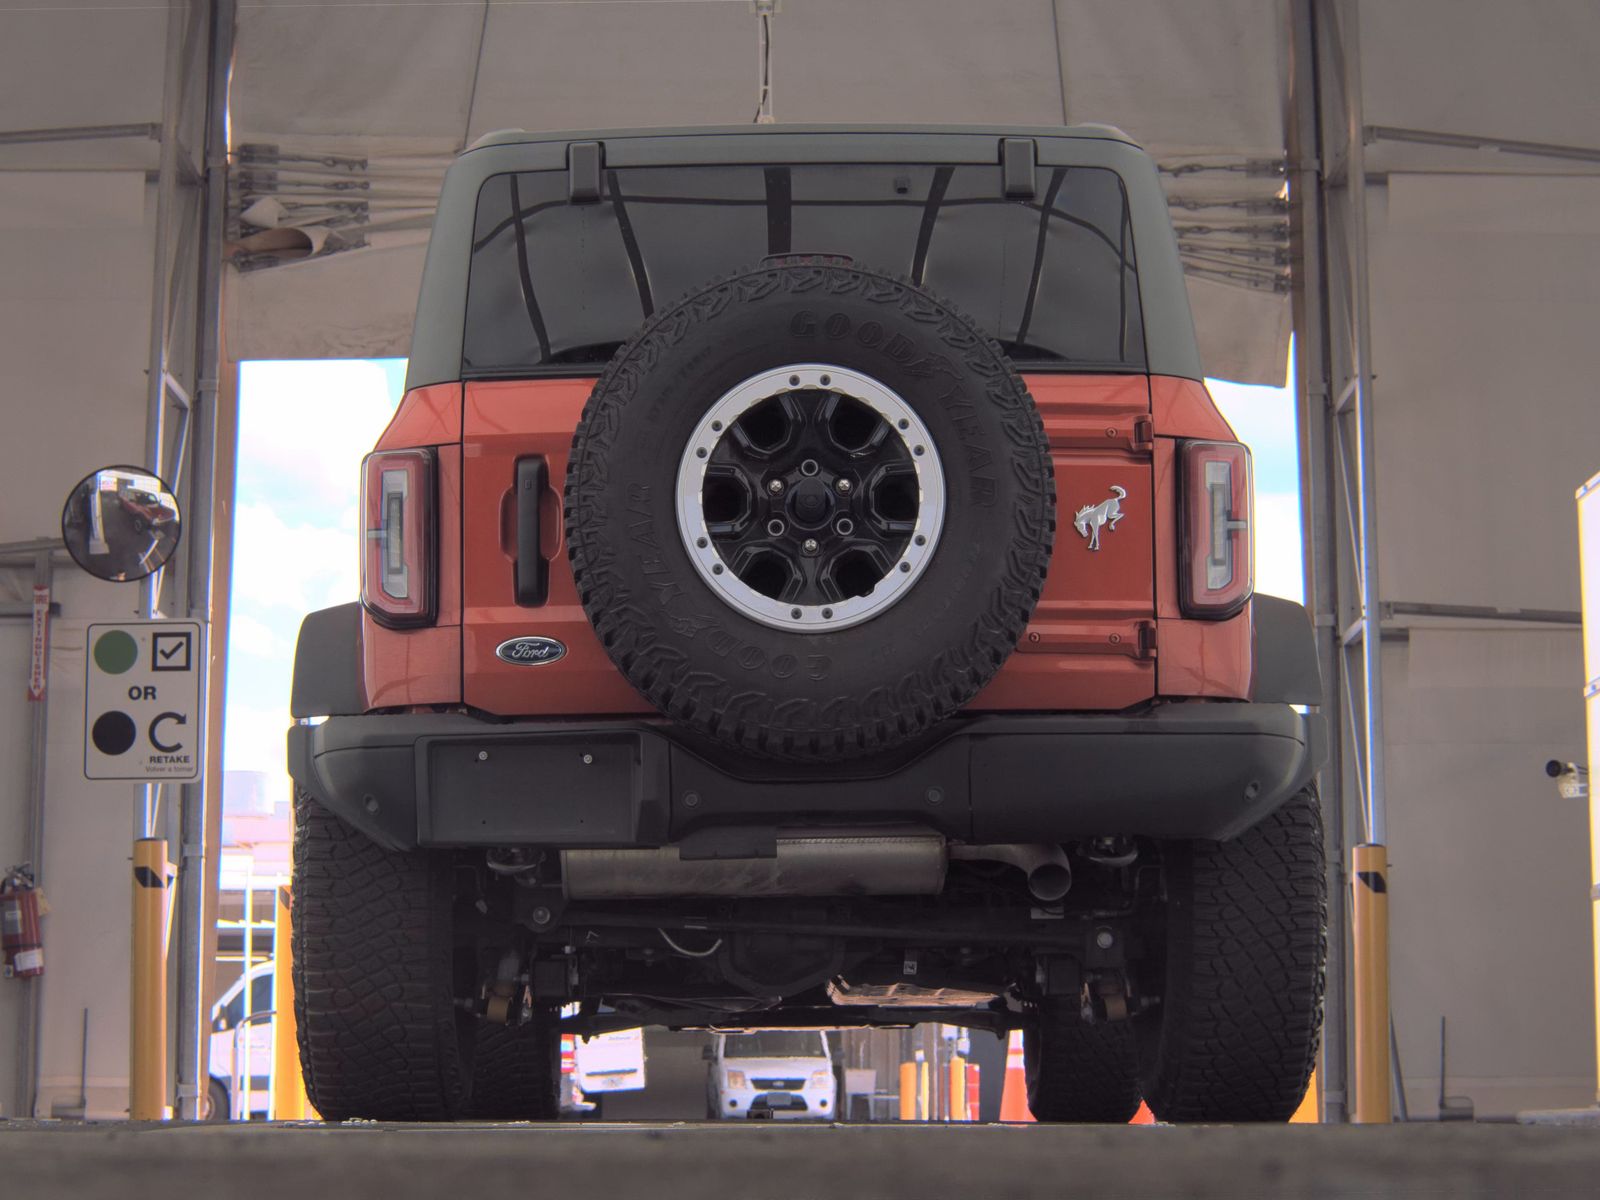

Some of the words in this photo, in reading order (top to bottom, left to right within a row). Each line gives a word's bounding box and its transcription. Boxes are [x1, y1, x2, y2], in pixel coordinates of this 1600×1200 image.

[511, 641, 550, 659] Ford
[128, 686, 157, 701] OR
[149, 755, 190, 764] RETAKE
